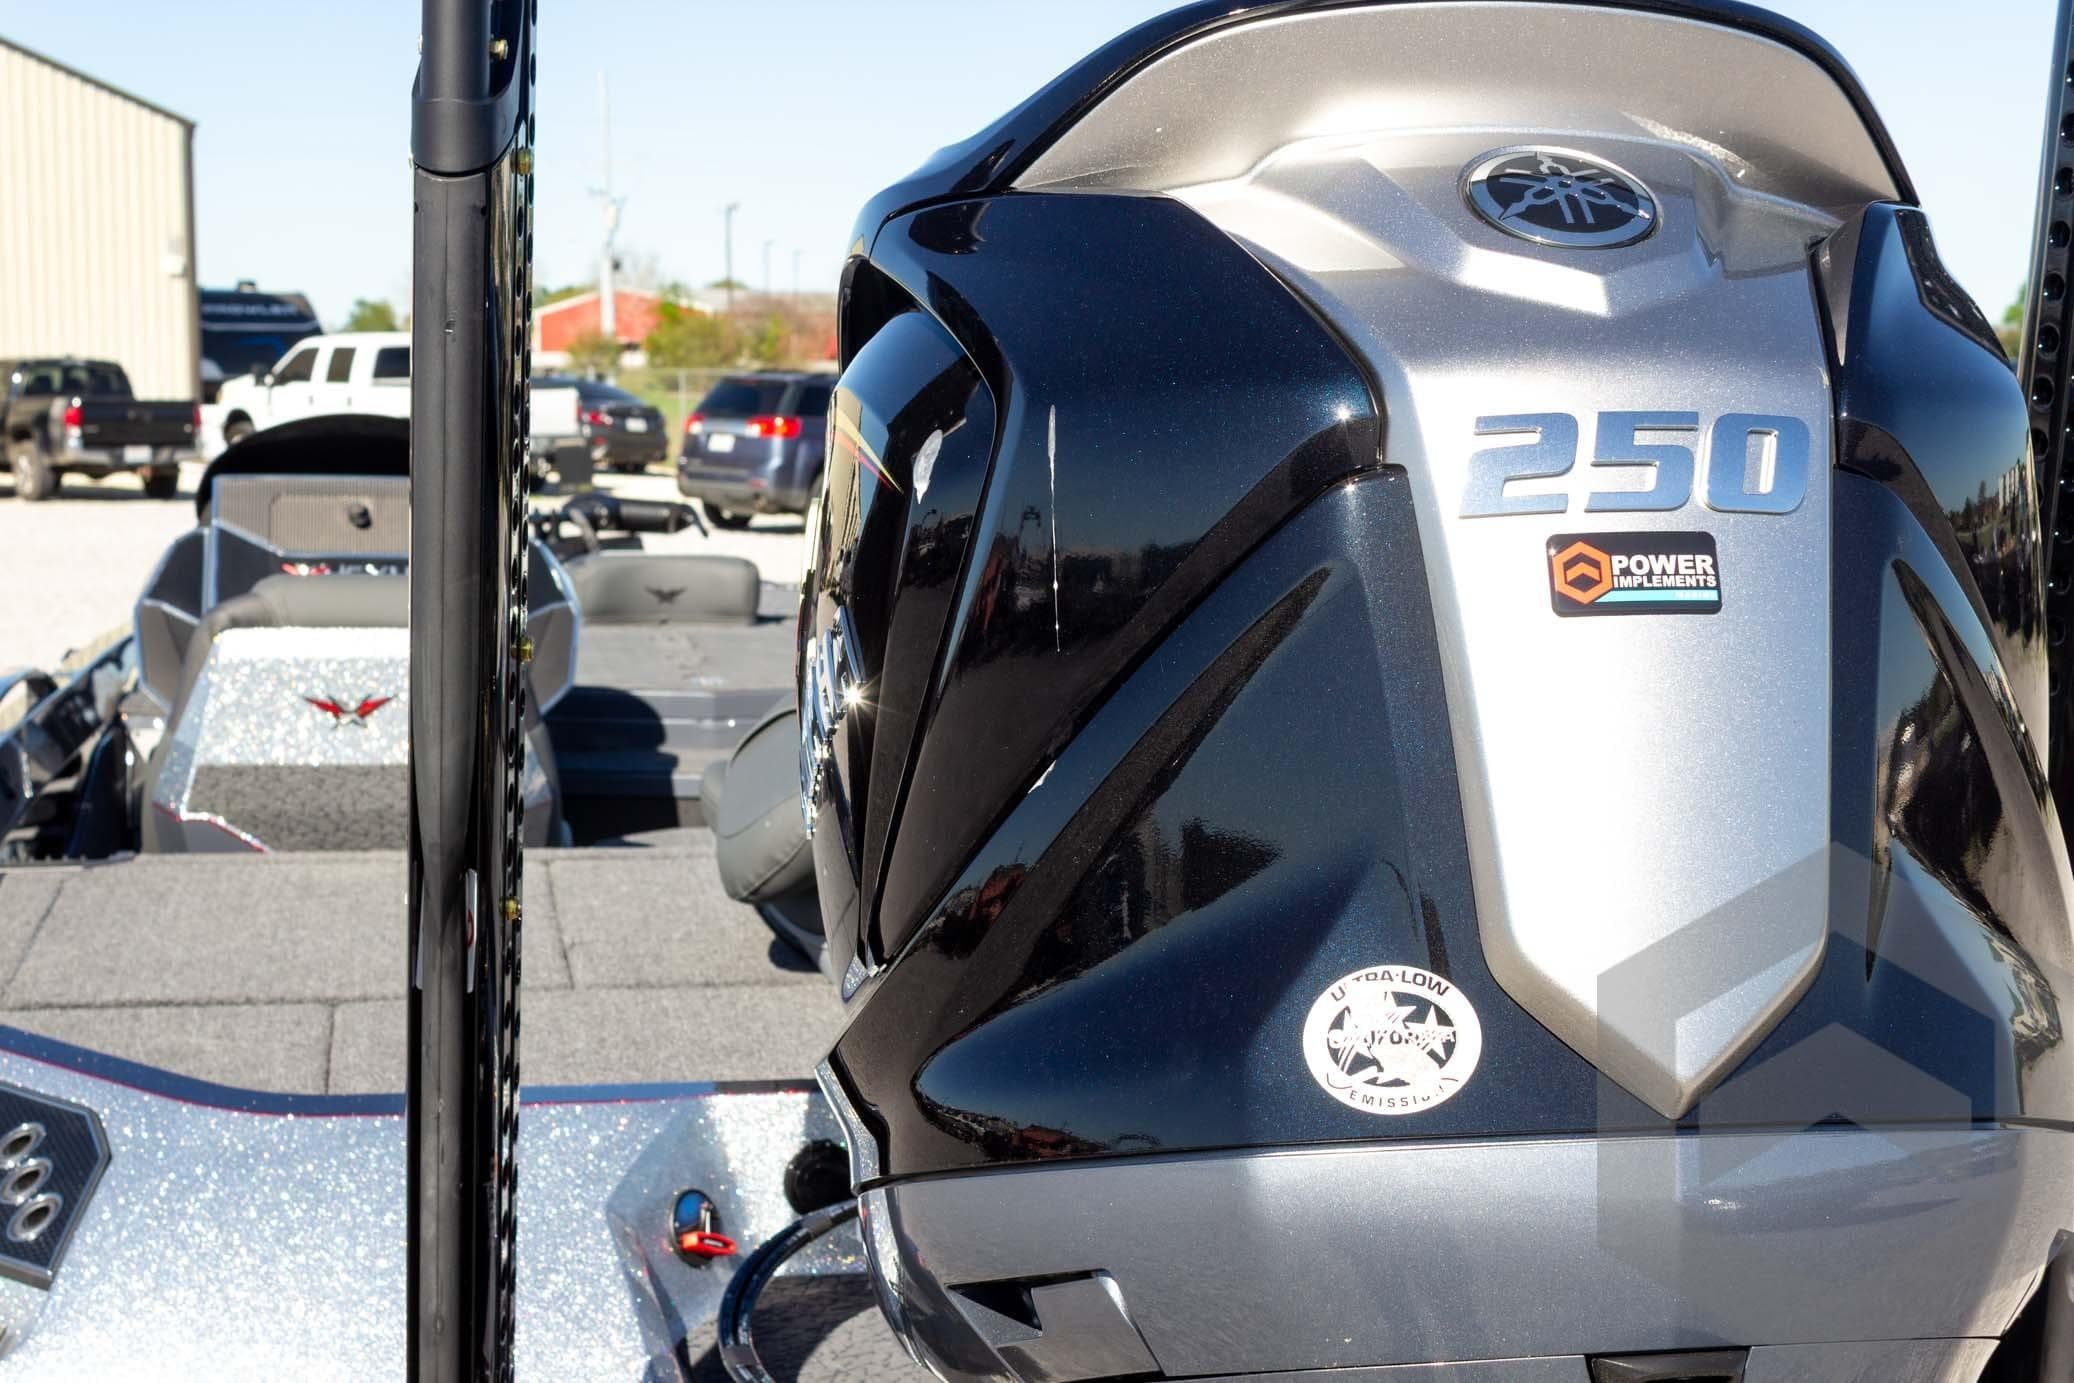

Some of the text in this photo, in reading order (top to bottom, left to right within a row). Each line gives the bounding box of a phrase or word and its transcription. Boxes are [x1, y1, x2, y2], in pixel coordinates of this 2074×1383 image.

[1459, 411, 1810, 518] 250
[1611, 554, 1715, 575] POWER
[1613, 575, 1717, 588] IMPLEMENTS
[1349, 1084, 1444, 1107] EMISSI
